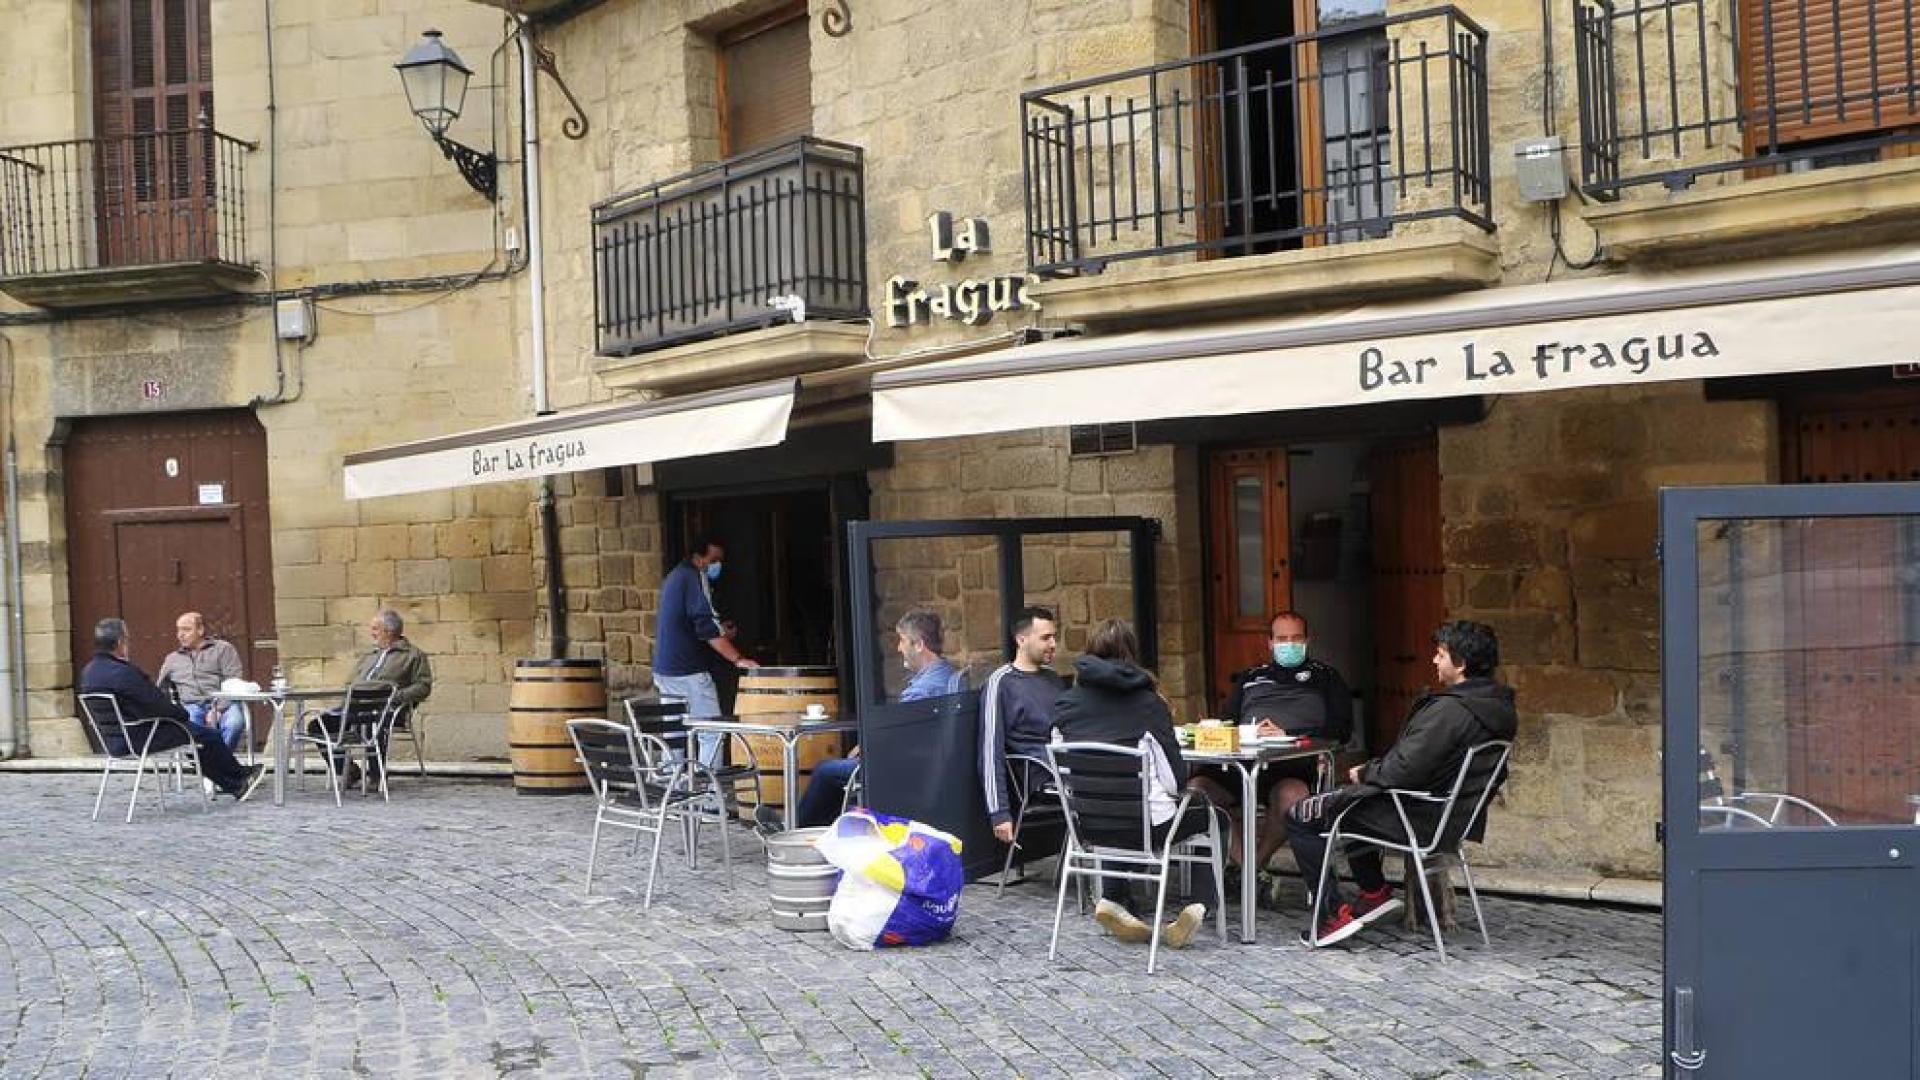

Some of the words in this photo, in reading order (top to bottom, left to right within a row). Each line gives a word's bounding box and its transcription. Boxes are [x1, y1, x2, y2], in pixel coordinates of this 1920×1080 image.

[929, 211, 991, 261] La
[1359, 347, 1437, 391] Bar
[1463, 342, 1514, 381] La
[472, 449, 499, 475] Bar
[505, 448, 524, 471] La
